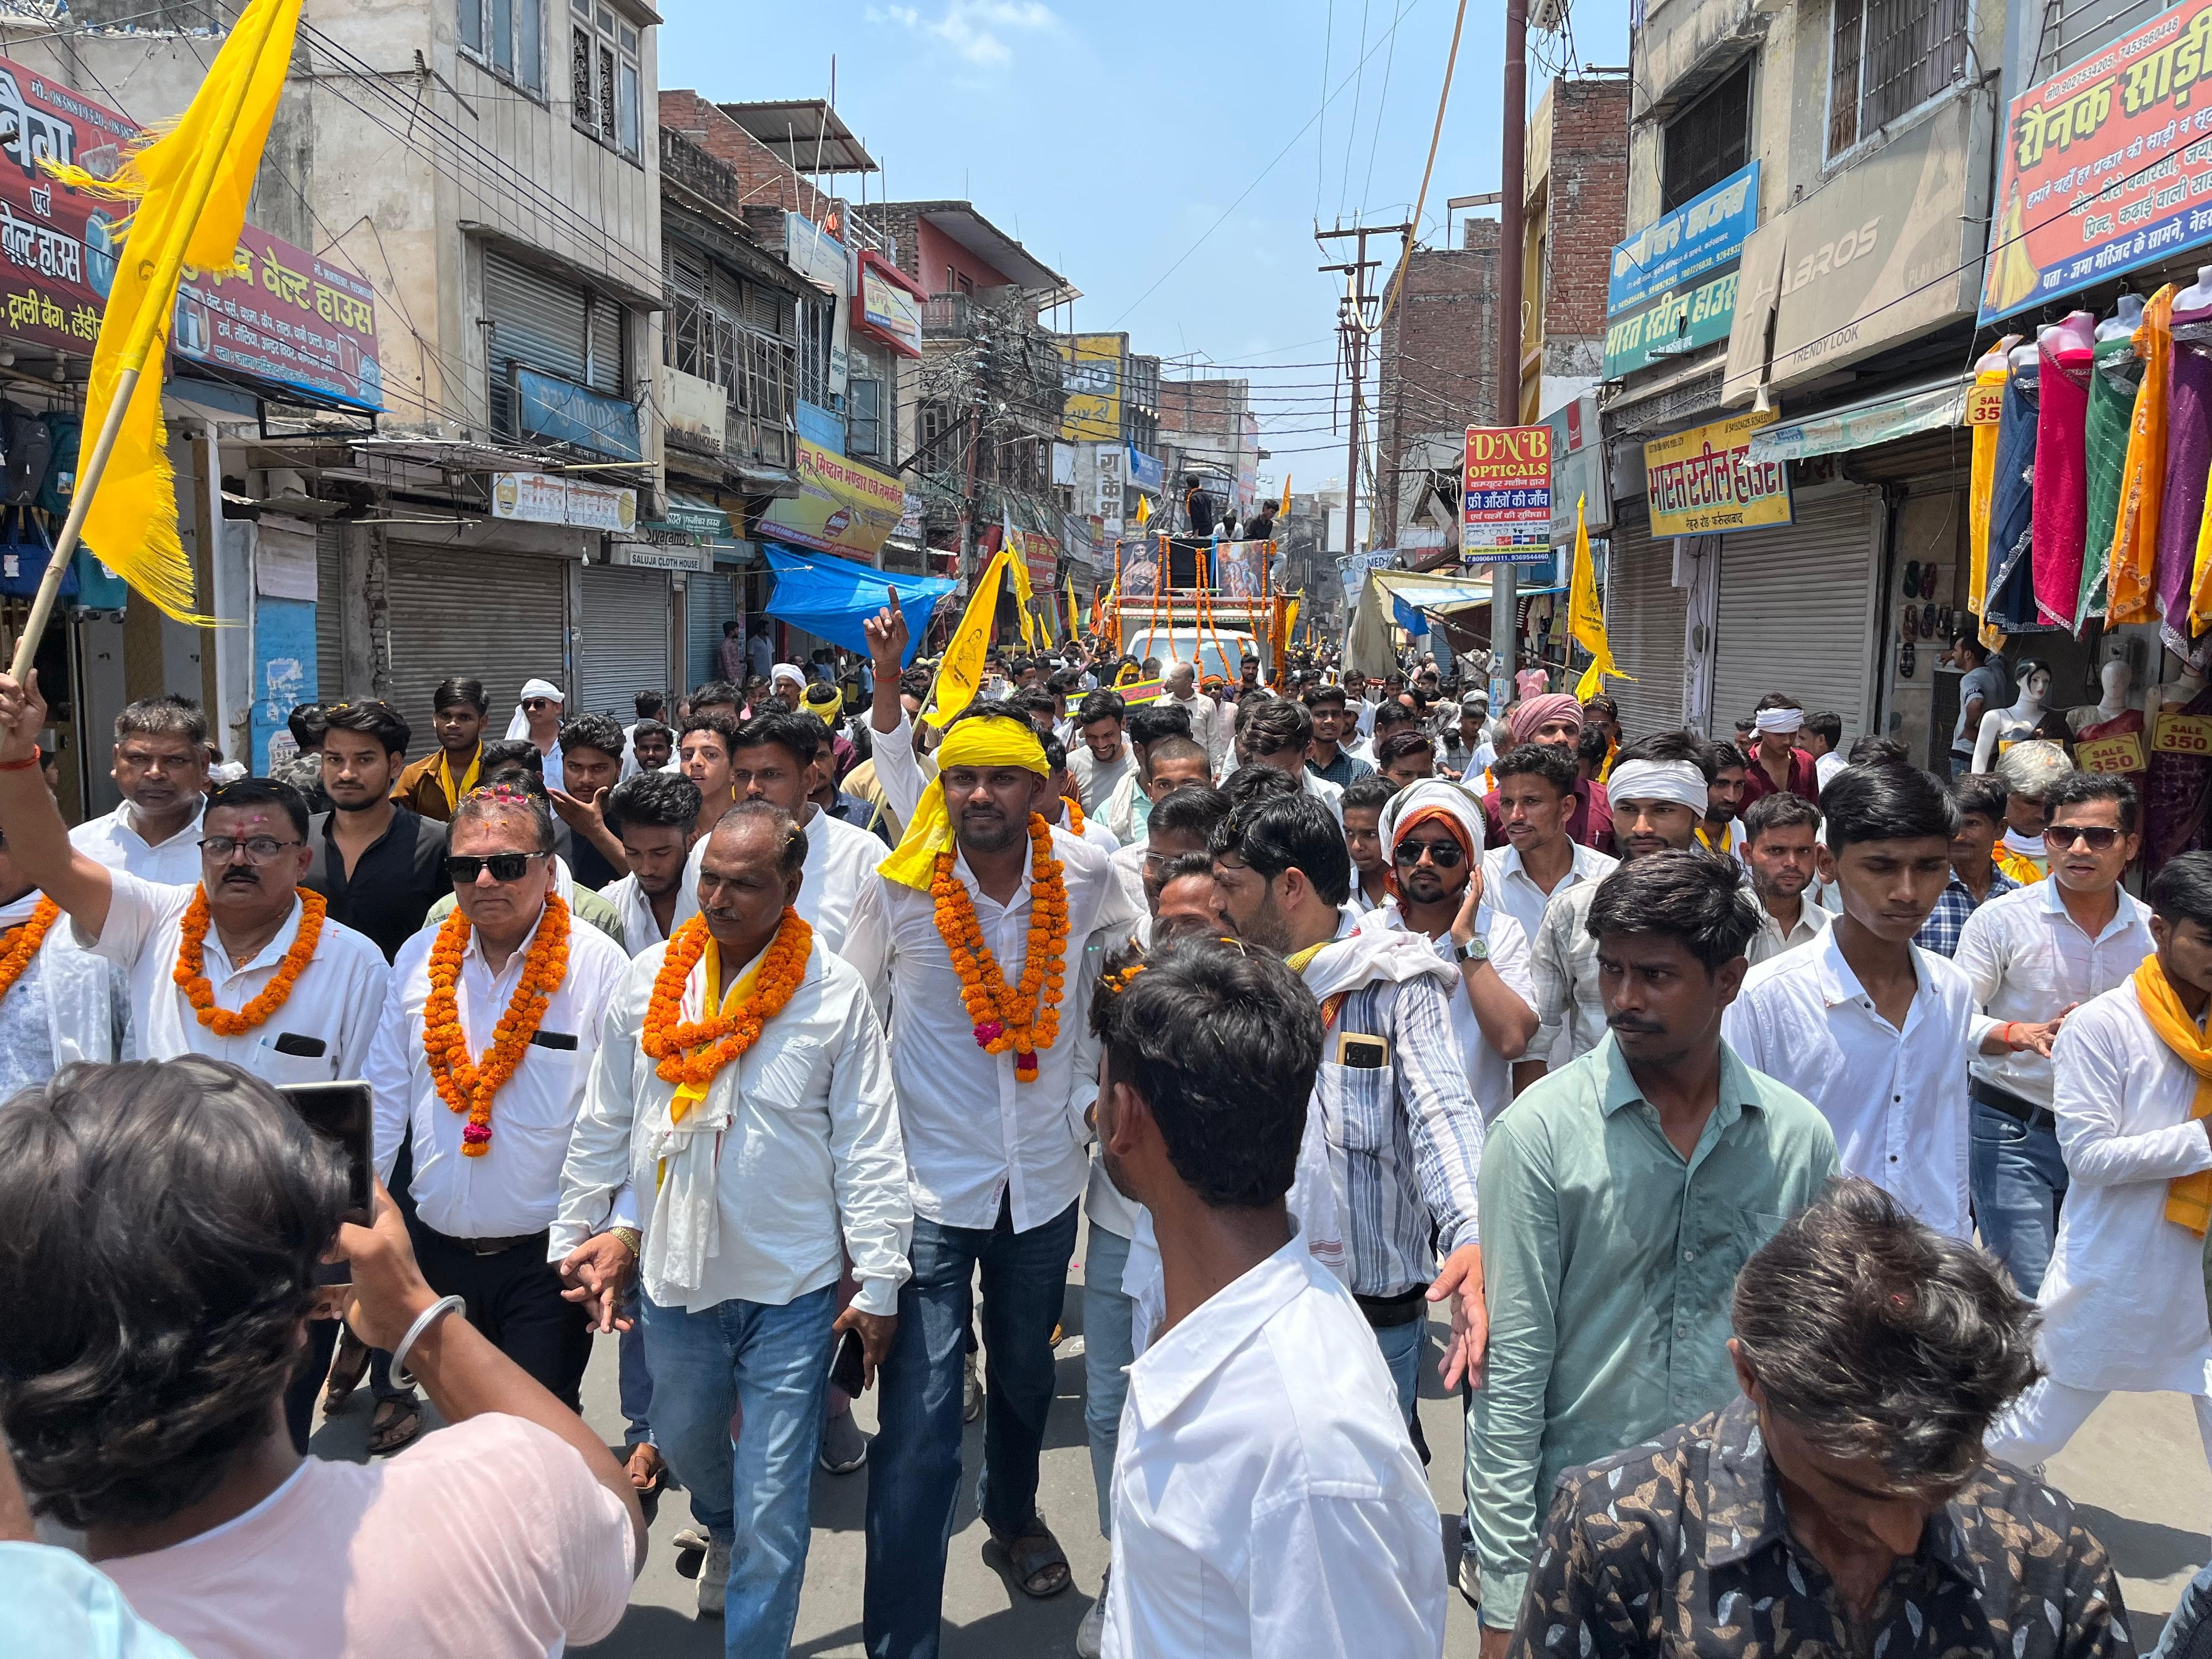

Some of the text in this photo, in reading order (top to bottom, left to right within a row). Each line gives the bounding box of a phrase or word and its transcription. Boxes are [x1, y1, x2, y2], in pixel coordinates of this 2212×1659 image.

[2019, 75, 2116, 167] रौनक
[2027, 179, 2051, 210] हमारे
[2077, 167, 2090, 186] हर
[2126, 135, 2143, 159] की
[2155, 174, 2188, 209] वाली
[37, 227, 81, 283] हाउस
[2043, 269, 2061, 289] पता
[2134, 233, 2145, 254] के
[313, 281, 373, 335] हाउस
[1605, 313, 1645, 357] भारत
[1793, 325, 1859, 365] TRENDY LOOK
[1980, 396, 2001, 405] SAL
[1974, 407, 2000, 420] 35
[700, 435, 720, 451] HOUSE
[1469, 431, 1548, 461] DNB
[1469, 463, 1547, 478] OPTICALS
[1648, 461, 1687, 511] भारत
[1468, 492, 1481, 510] फ्री
[1512, 490, 1526, 507] की
[632, 554, 698, 569] SALUJA CLOTH HOUSE
[2171, 724, 2203, 735] SALE
[2092, 746, 2125, 759] SALE
[2163, 734, 2208, 751] 350
[2089, 755, 2134, 774] 350
